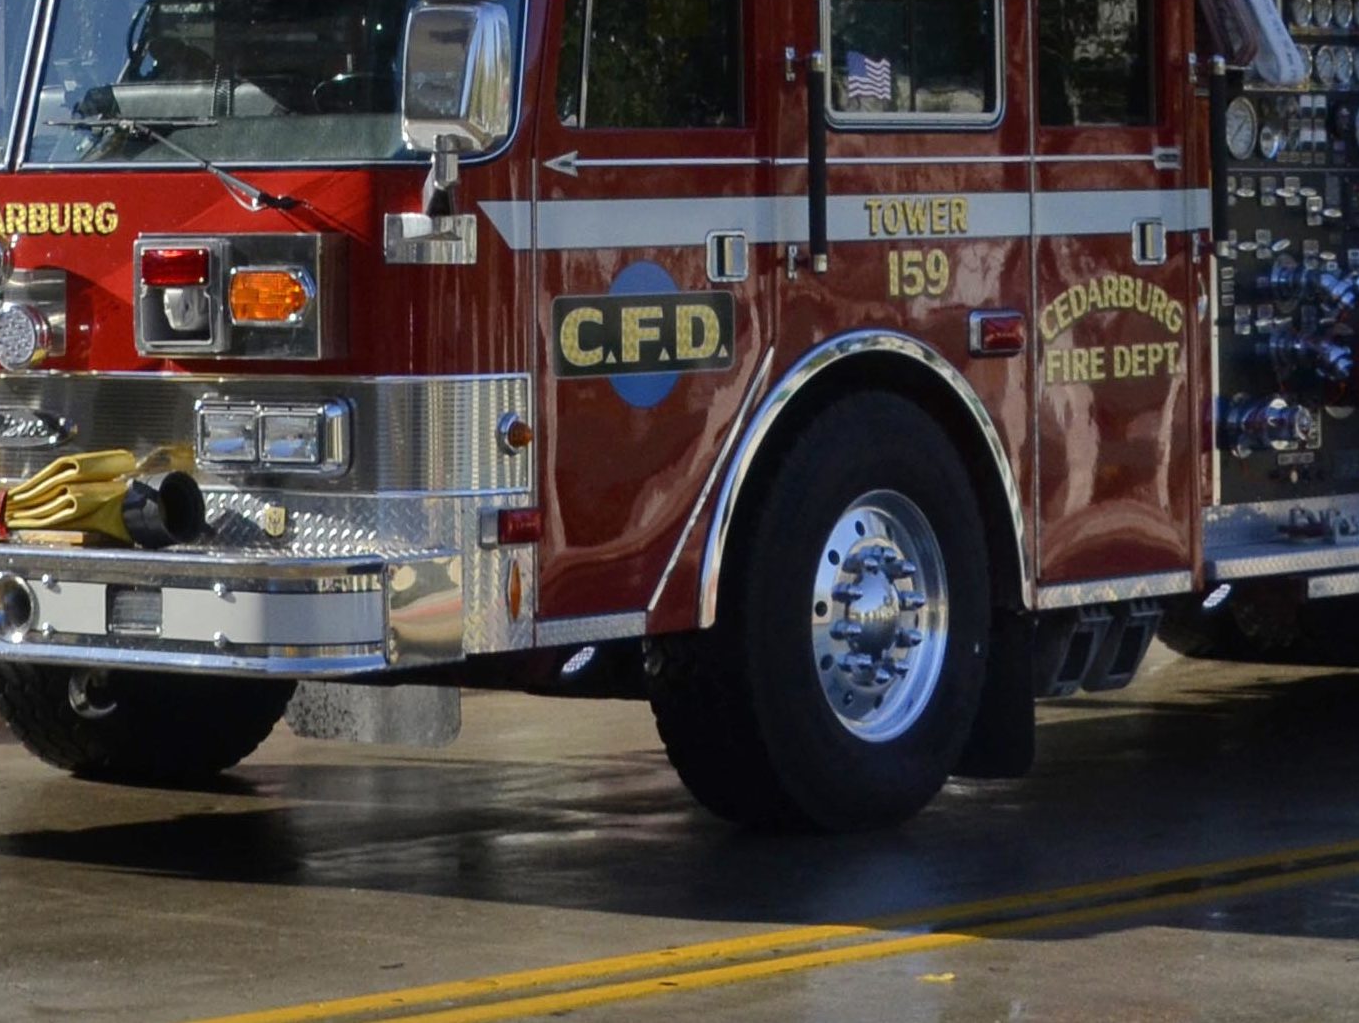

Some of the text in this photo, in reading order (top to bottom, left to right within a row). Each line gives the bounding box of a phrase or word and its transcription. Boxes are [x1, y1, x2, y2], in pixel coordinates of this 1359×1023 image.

[863, 196, 968, 236] TOWER
[887, 247, 950, 297] 159
[1040, 274, 1184, 341] CEDARBURG
[560, 304, 729, 367] C.F.D.
[1045, 341, 1182, 383] FIRE DEPT.
